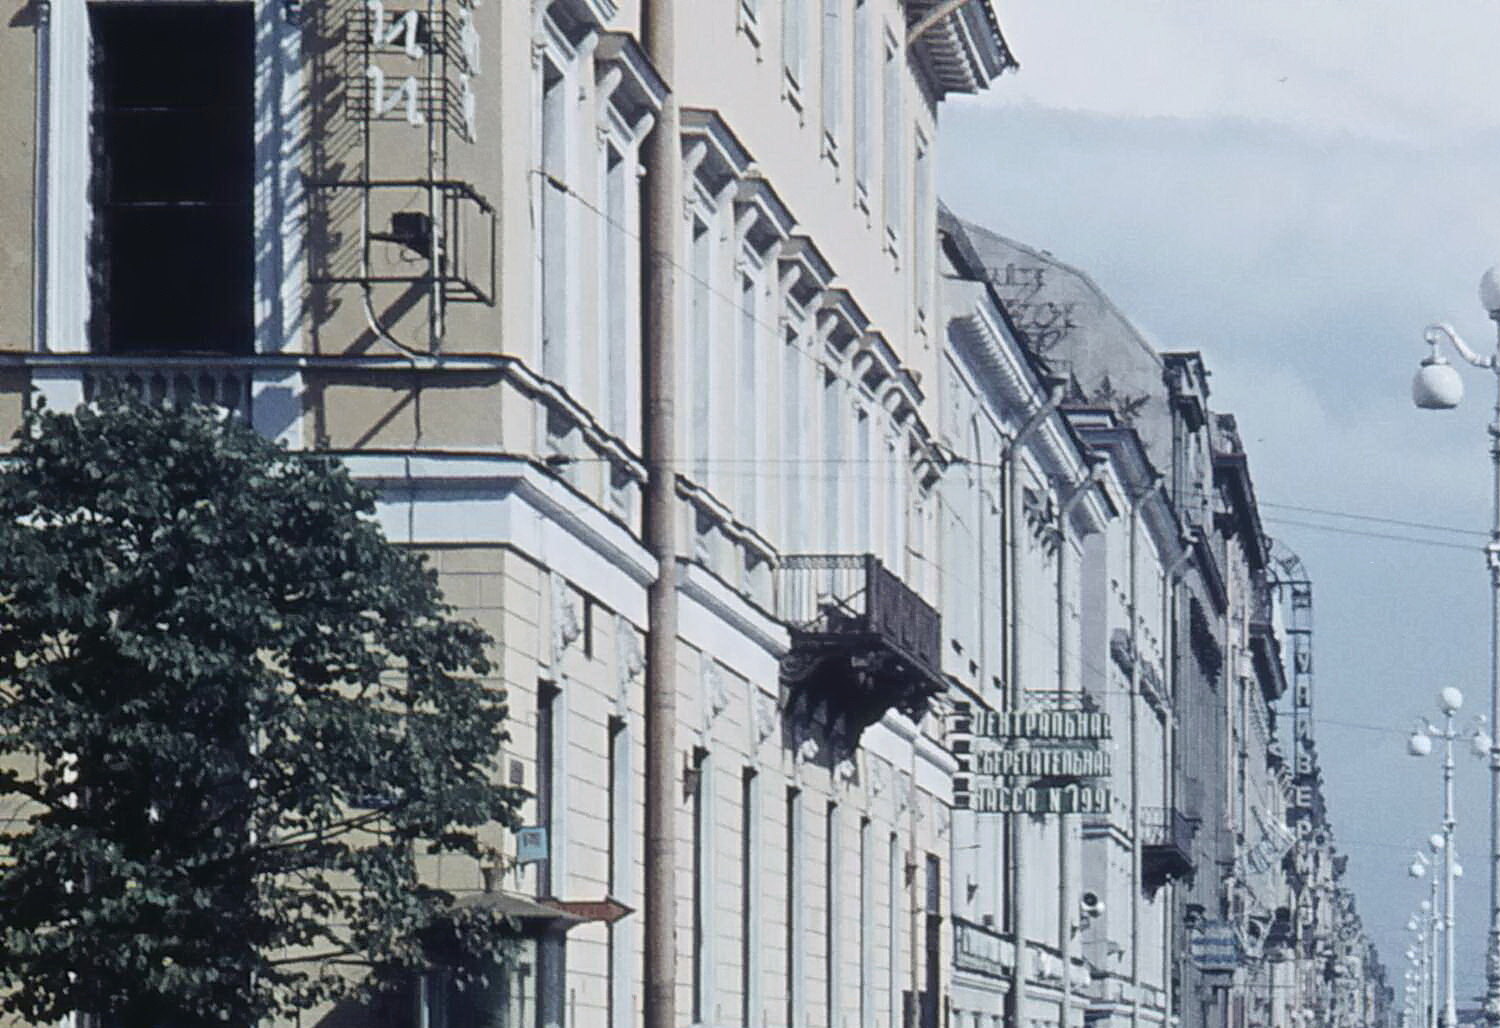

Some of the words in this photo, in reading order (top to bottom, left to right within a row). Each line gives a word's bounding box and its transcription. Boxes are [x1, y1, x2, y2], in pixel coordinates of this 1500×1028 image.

[973, 710, 1112, 738] ЦЕНТРАЛЬНАЯ
[974, 749, 1112, 776] СБЕРЕГАТЕЛЬНАЯ
[973, 786, 1037, 813] КАССА
